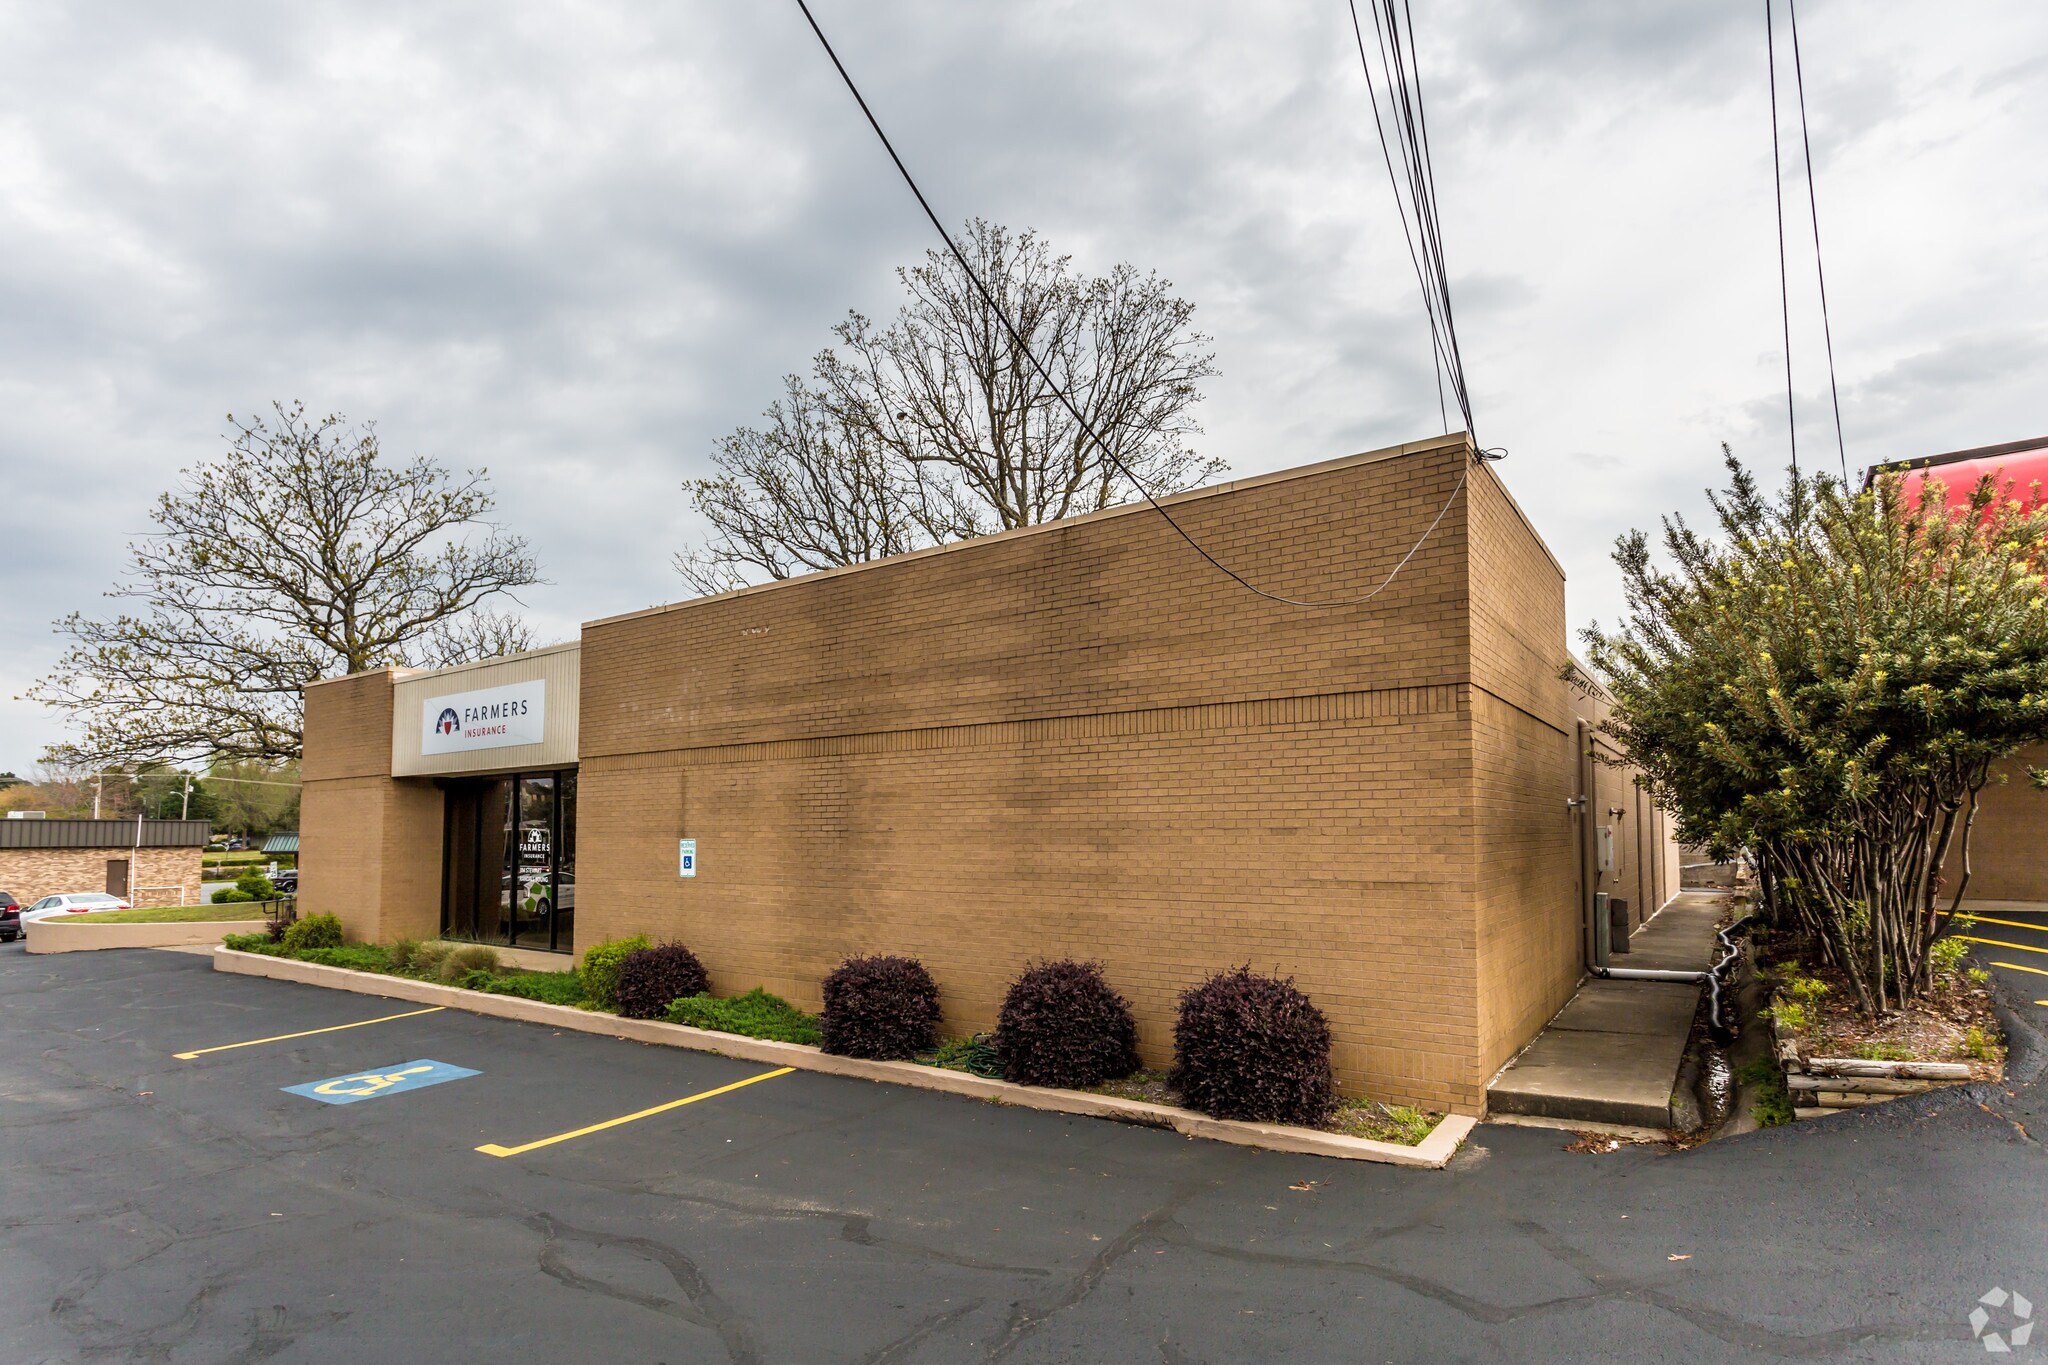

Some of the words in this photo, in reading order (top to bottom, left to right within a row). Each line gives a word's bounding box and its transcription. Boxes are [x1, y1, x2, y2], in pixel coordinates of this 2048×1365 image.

[465, 700, 528, 722] FARMERS
[464, 724, 506, 738] INSURANCE
[519, 843, 550, 851] FARMERS
